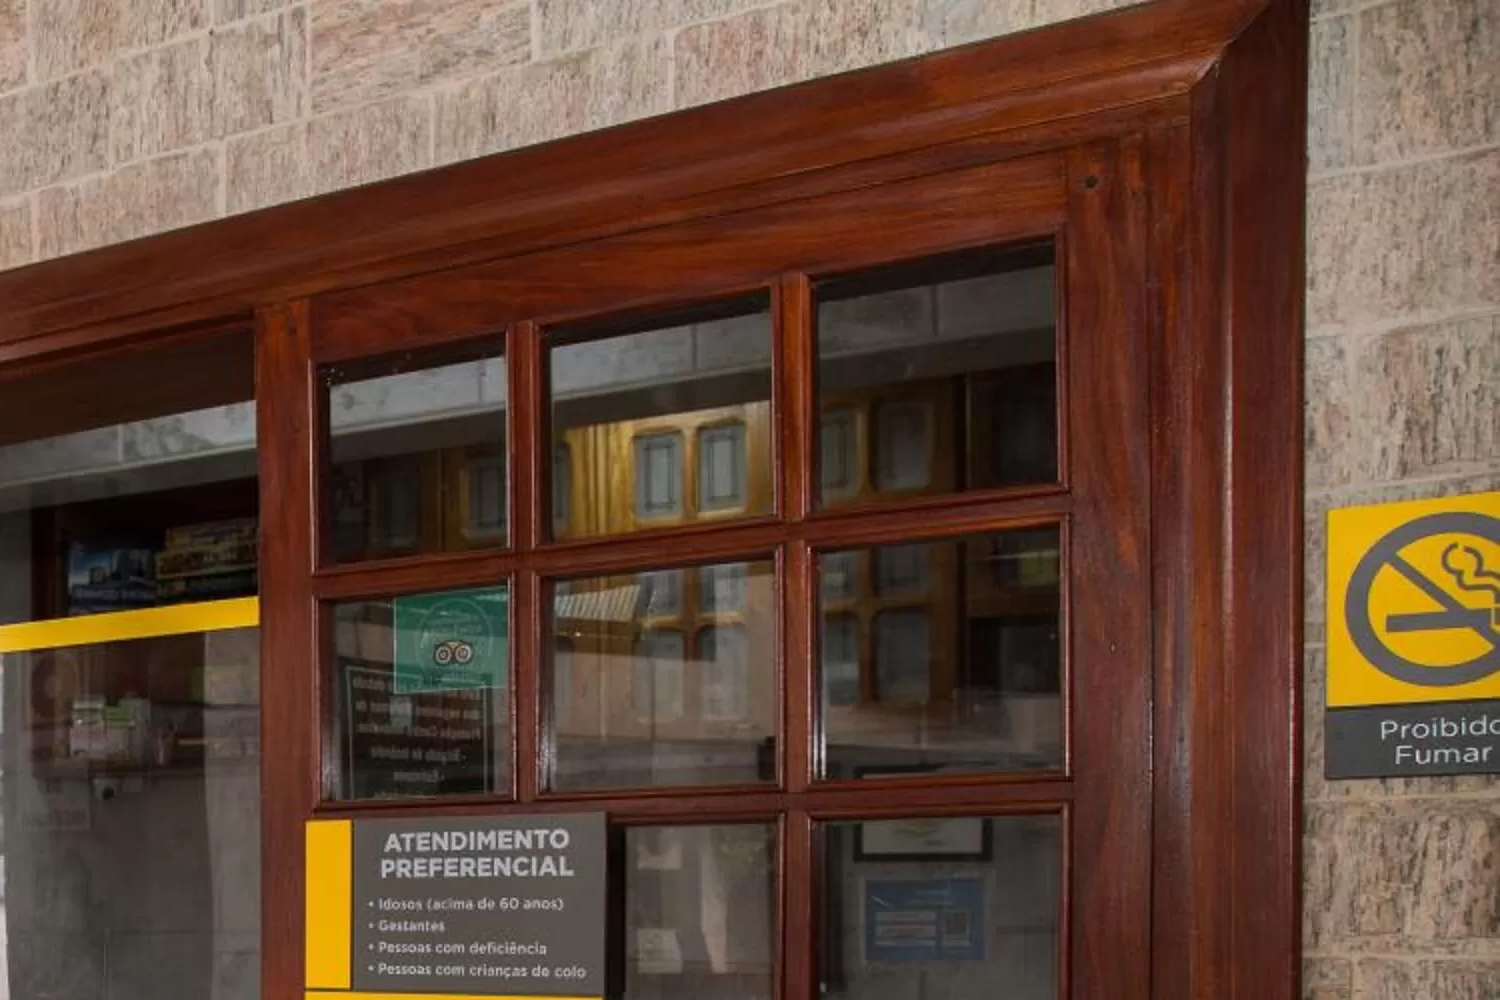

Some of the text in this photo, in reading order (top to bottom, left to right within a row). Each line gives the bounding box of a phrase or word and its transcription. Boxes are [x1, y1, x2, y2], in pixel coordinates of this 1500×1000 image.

[1395, 745, 1493, 765] Fumar
[383, 829, 570, 852] ATENDIMENTO
[380, 856, 574, 878] PREFERENCIAL
[379, 897, 565, 912] Idosos (acima de 60 anos)
[378, 919, 445, 932] Gestantes
[379, 941, 547, 956] Pessoas com deficiência
[379, 963, 432, 976] Pessoas
[435, 964, 465, 977] com
[469, 963, 528, 982] crianças
[554, 964, 587, 979] colo
